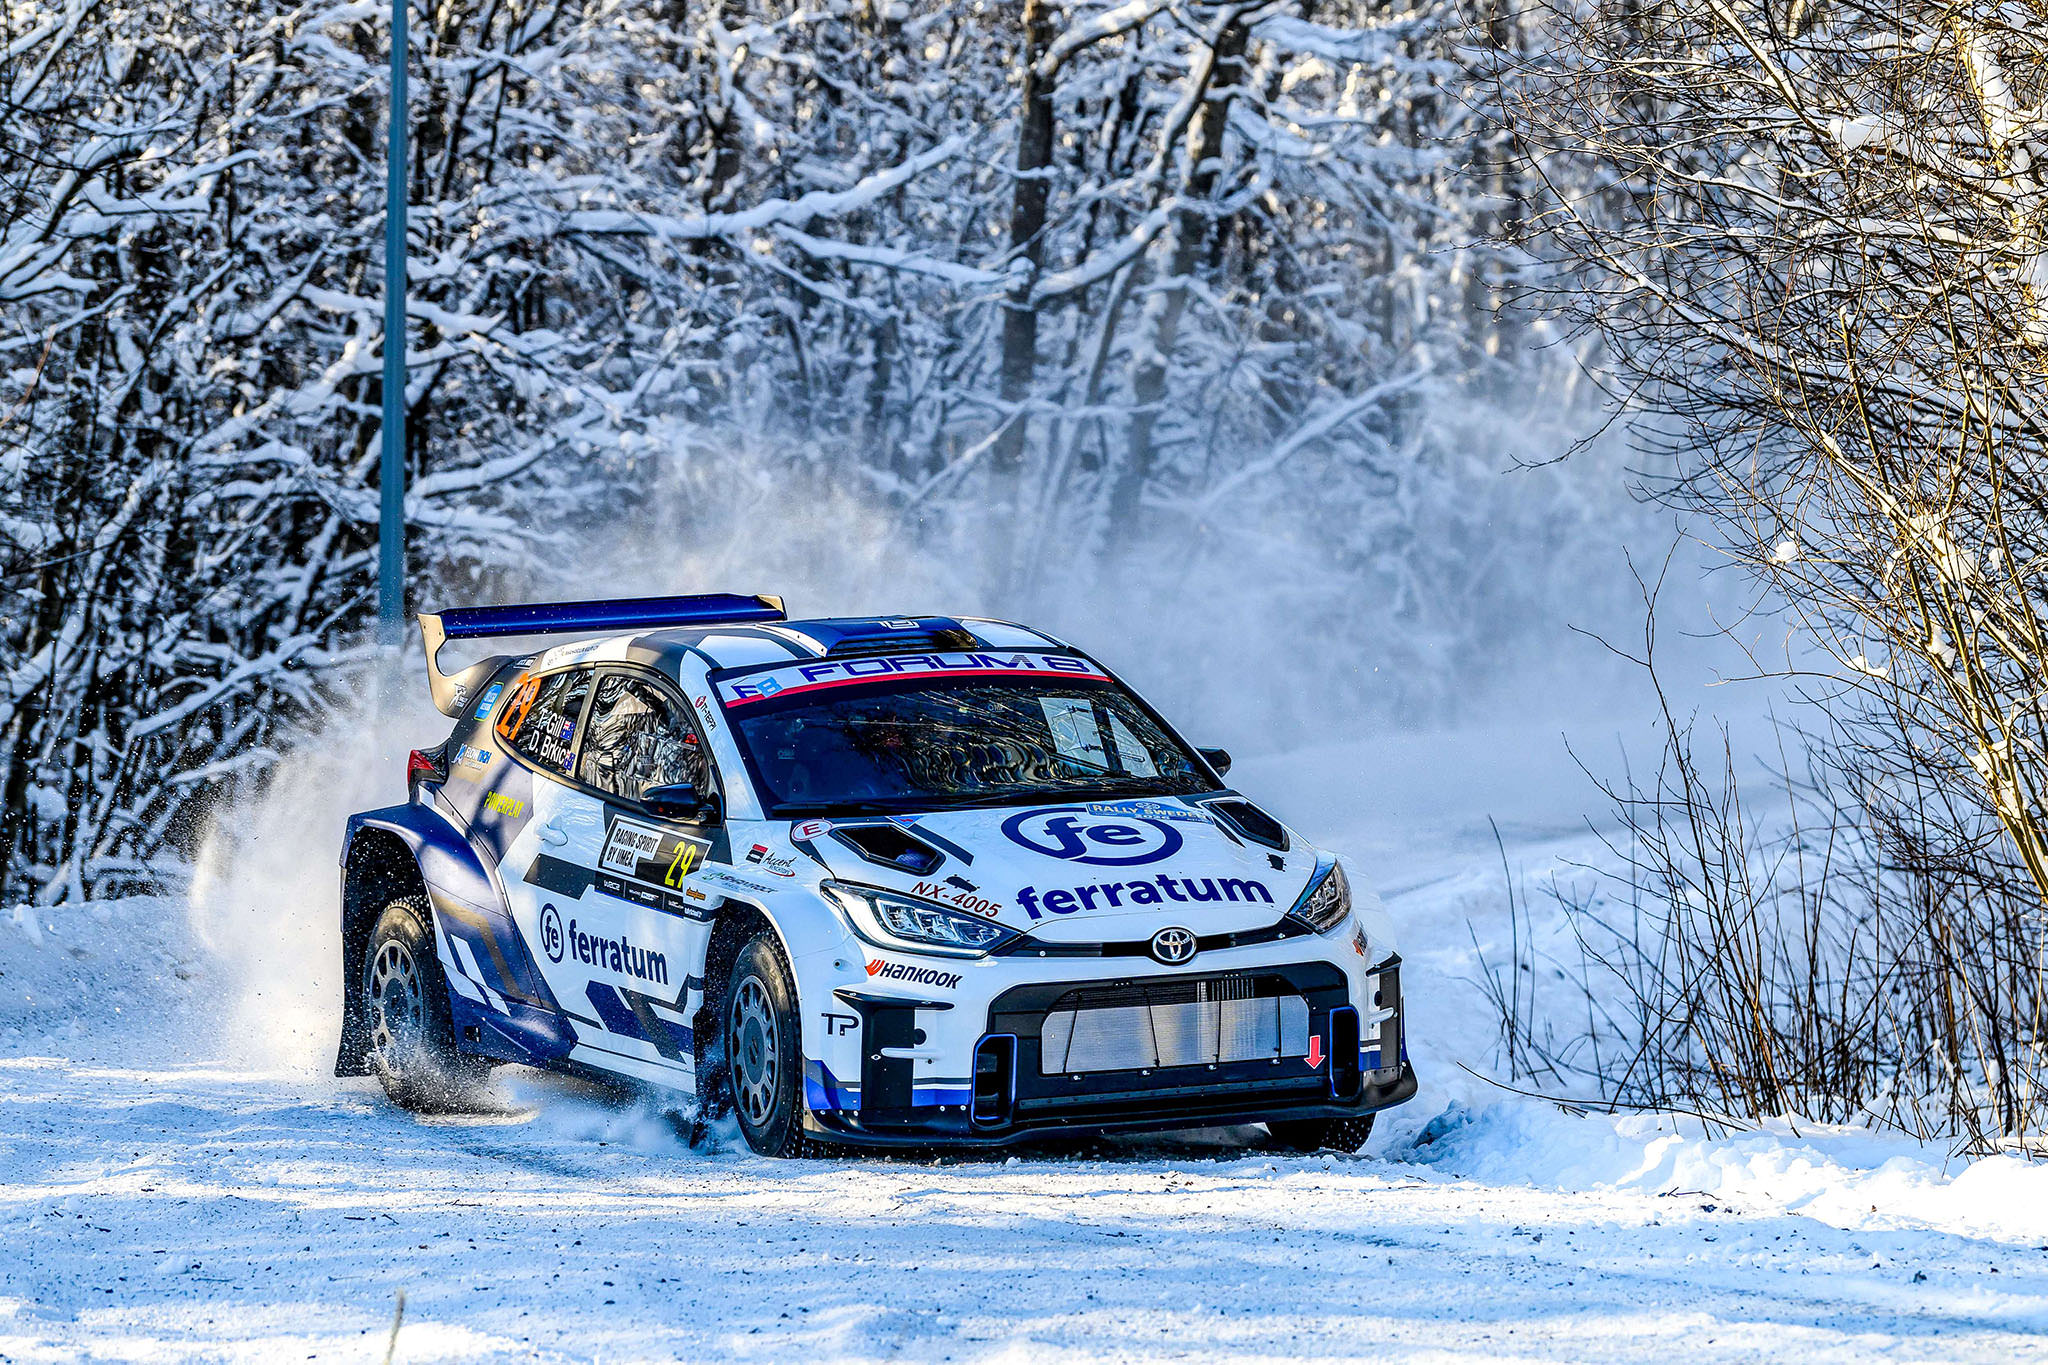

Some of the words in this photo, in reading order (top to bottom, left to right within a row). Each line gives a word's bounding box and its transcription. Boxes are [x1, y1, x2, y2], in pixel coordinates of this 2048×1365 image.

[799, 654, 1034, 682] FORUM
[1041, 655, 1090, 673] 8
[495, 673, 542, 741] 29
[546, 712, 566, 738] Gill
[528, 729, 540, 753] D.
[484, 790, 525, 818] POWERPLAY
[1092, 804, 1138, 814] RALLY
[613, 828, 638, 848] RACING
[635, 834, 659, 854] SPIRIT
[803, 823, 822, 836] E
[606, 846, 617, 862] BY
[664, 841, 697, 888] 29
[763, 852, 798, 868] Accent
[911, 881, 1002, 918] NX-4005
[1016, 873, 1275, 920] ferratum
[568, 918, 669, 985] ferratum
